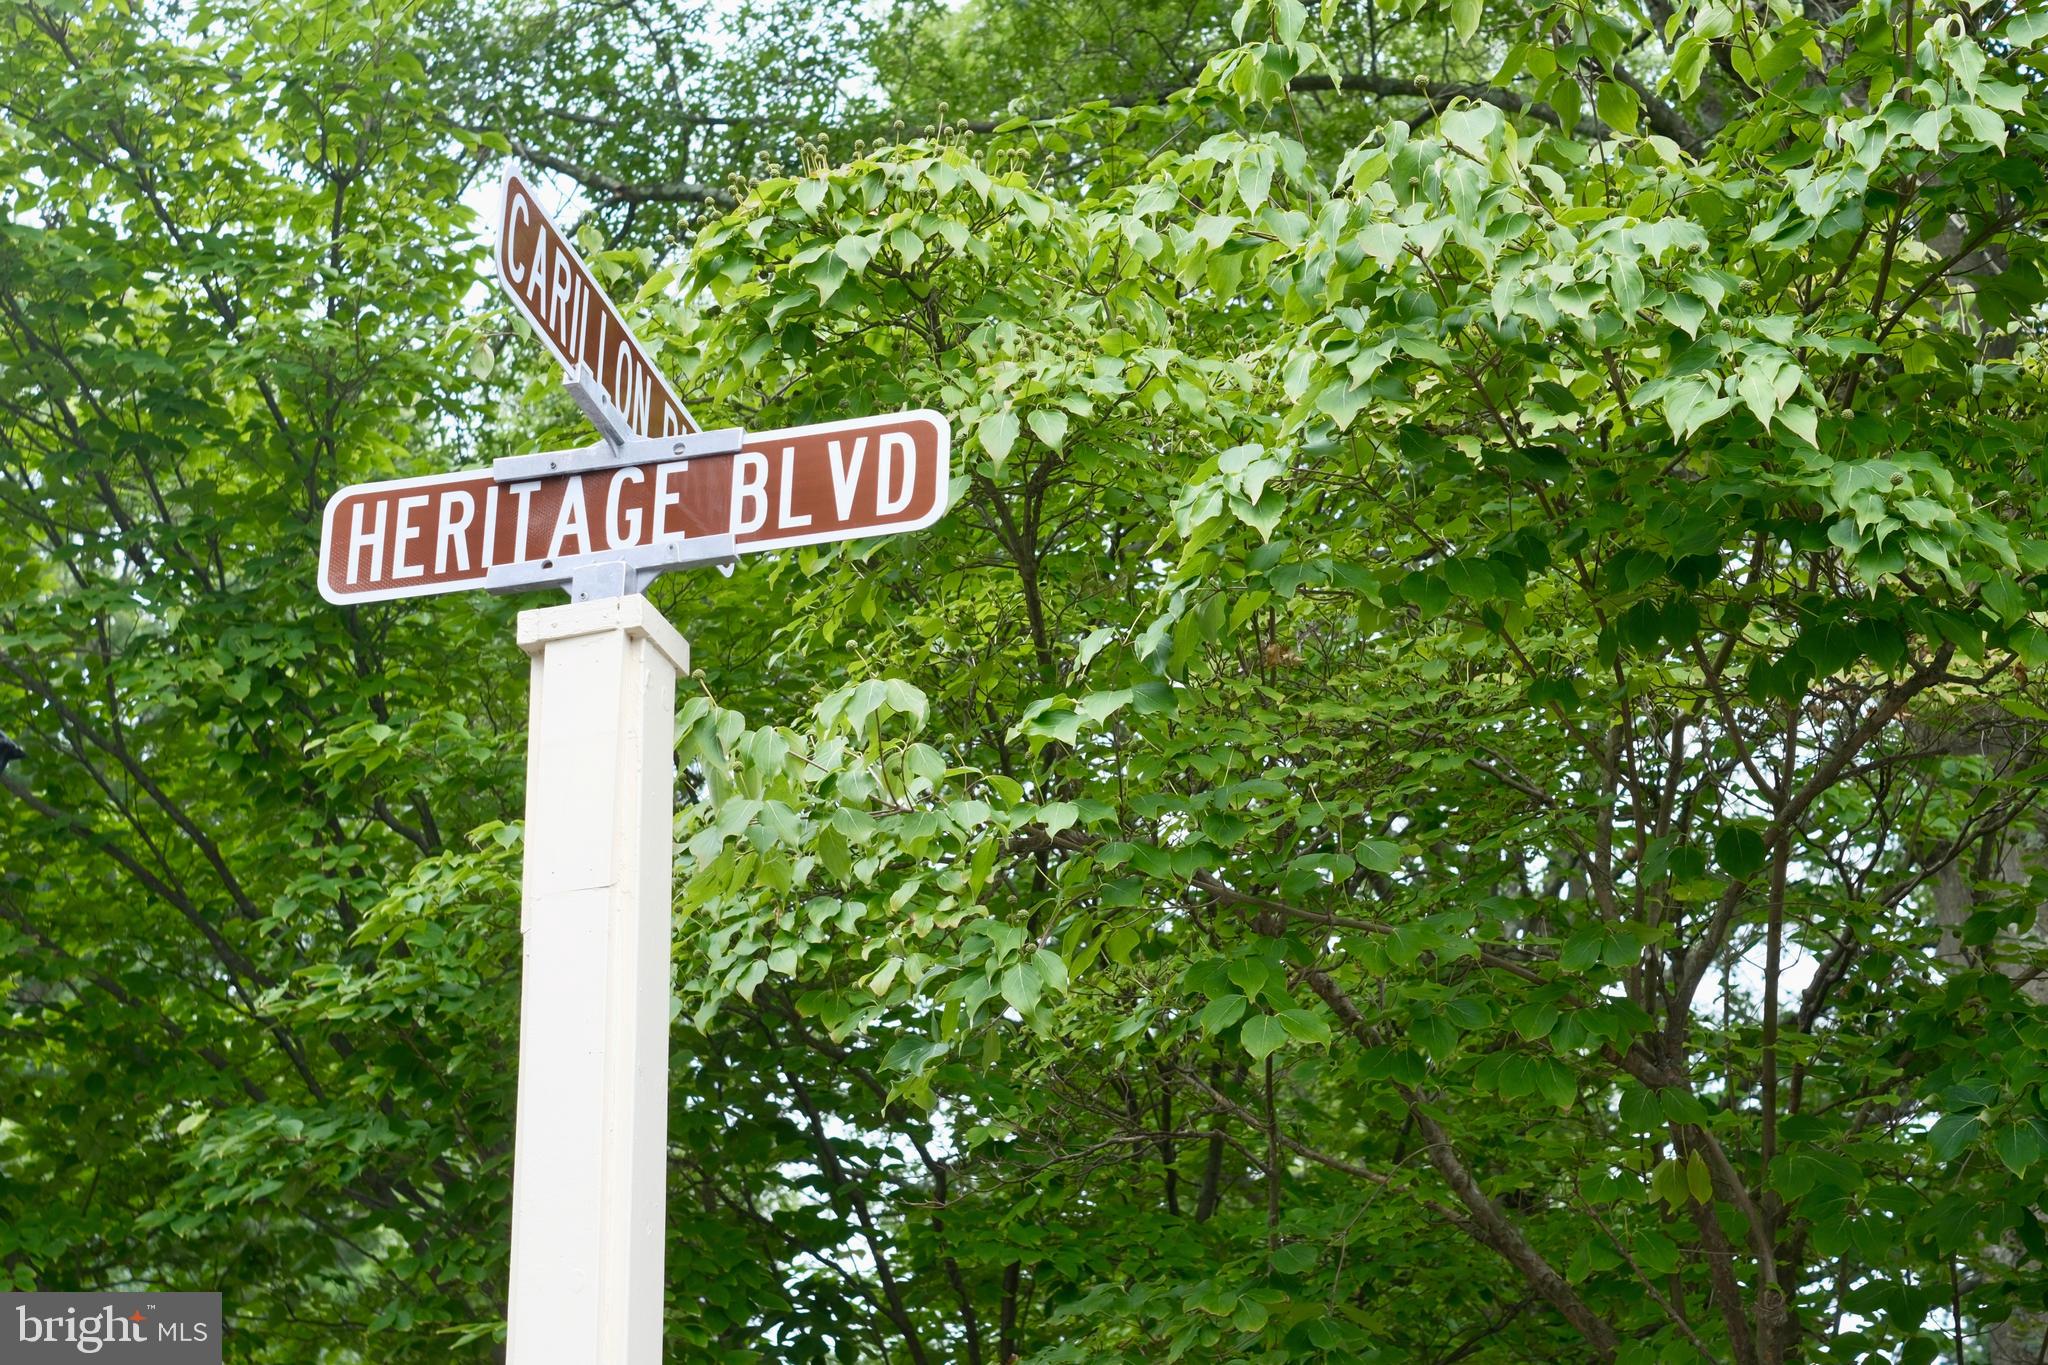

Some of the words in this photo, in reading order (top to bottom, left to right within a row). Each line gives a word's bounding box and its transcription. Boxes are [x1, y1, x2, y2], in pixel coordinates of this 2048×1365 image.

[507, 192, 652, 439] CARILLON
[345, 461, 689, 585] HERITAGE
[729, 432, 917, 534] BLVD
